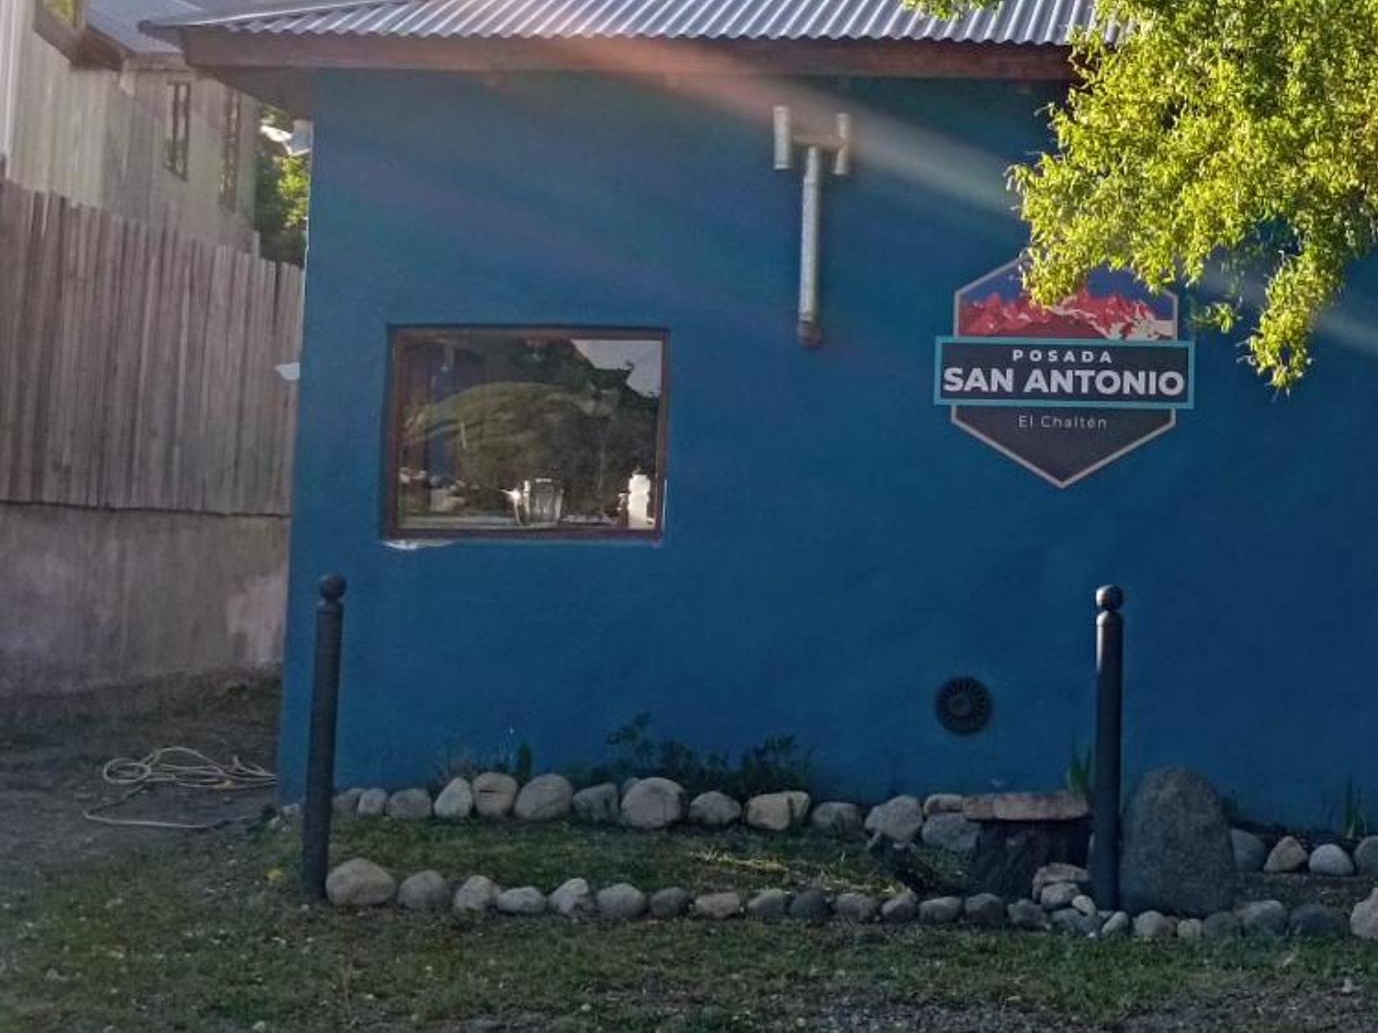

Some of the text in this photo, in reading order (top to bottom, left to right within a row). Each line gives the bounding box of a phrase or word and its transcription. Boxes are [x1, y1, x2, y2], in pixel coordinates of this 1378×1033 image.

[1013, 349, 1113, 363] POSADA
[943, 367, 1185, 395] SAN ANTONIO
[1018, 415, 1033, 429] El
